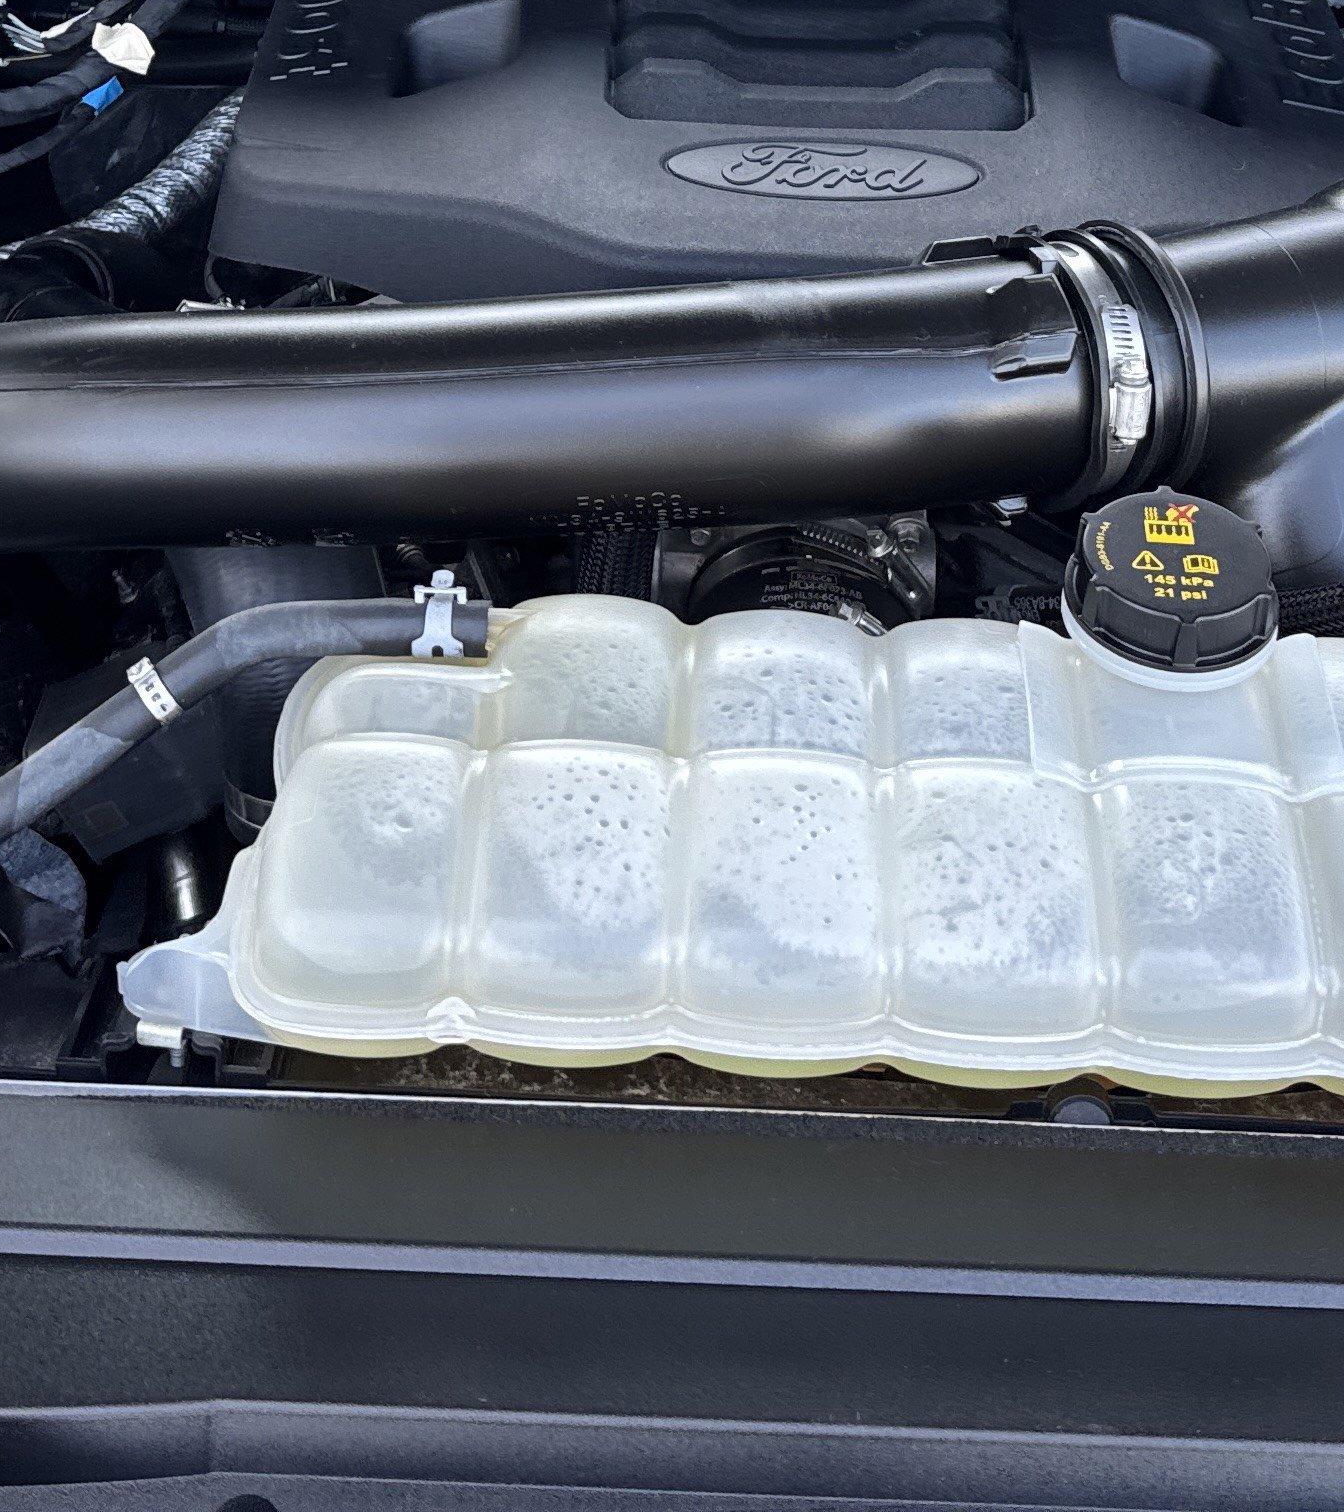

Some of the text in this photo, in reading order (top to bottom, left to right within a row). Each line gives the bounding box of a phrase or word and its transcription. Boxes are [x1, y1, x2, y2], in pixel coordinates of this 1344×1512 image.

[722, 146, 933, 193] Ford
[1145, 575, 1214, 588] 145 kPa
[1155, 588, 1207, 600] 21 psi
